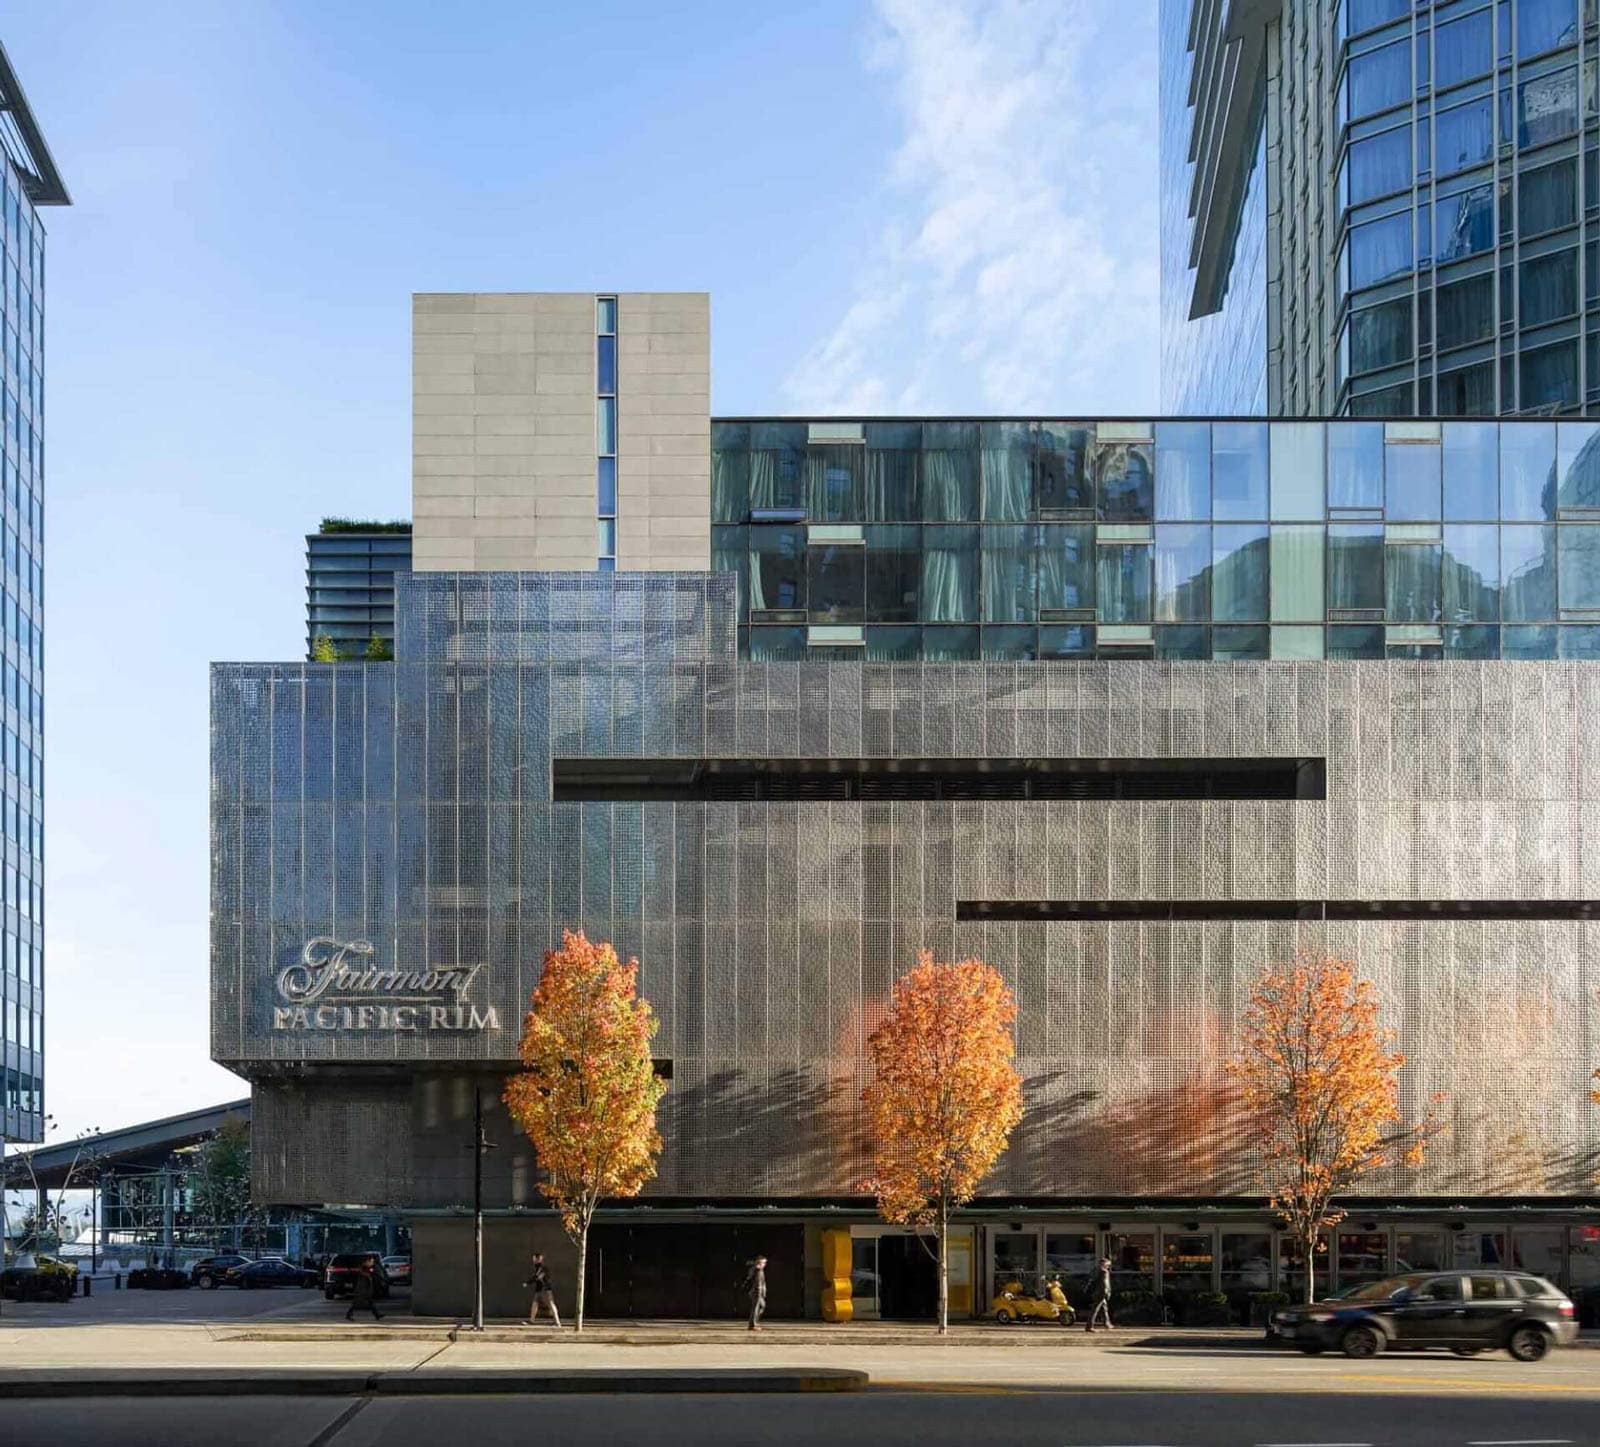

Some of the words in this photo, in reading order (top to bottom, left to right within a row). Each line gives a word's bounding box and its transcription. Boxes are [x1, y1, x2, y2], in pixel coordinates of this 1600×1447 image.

[278, 937, 489, 1003] Fairmont
[273, 1006, 417, 1030] PACIFIC
[429, 1006, 500, 1030] RIM
